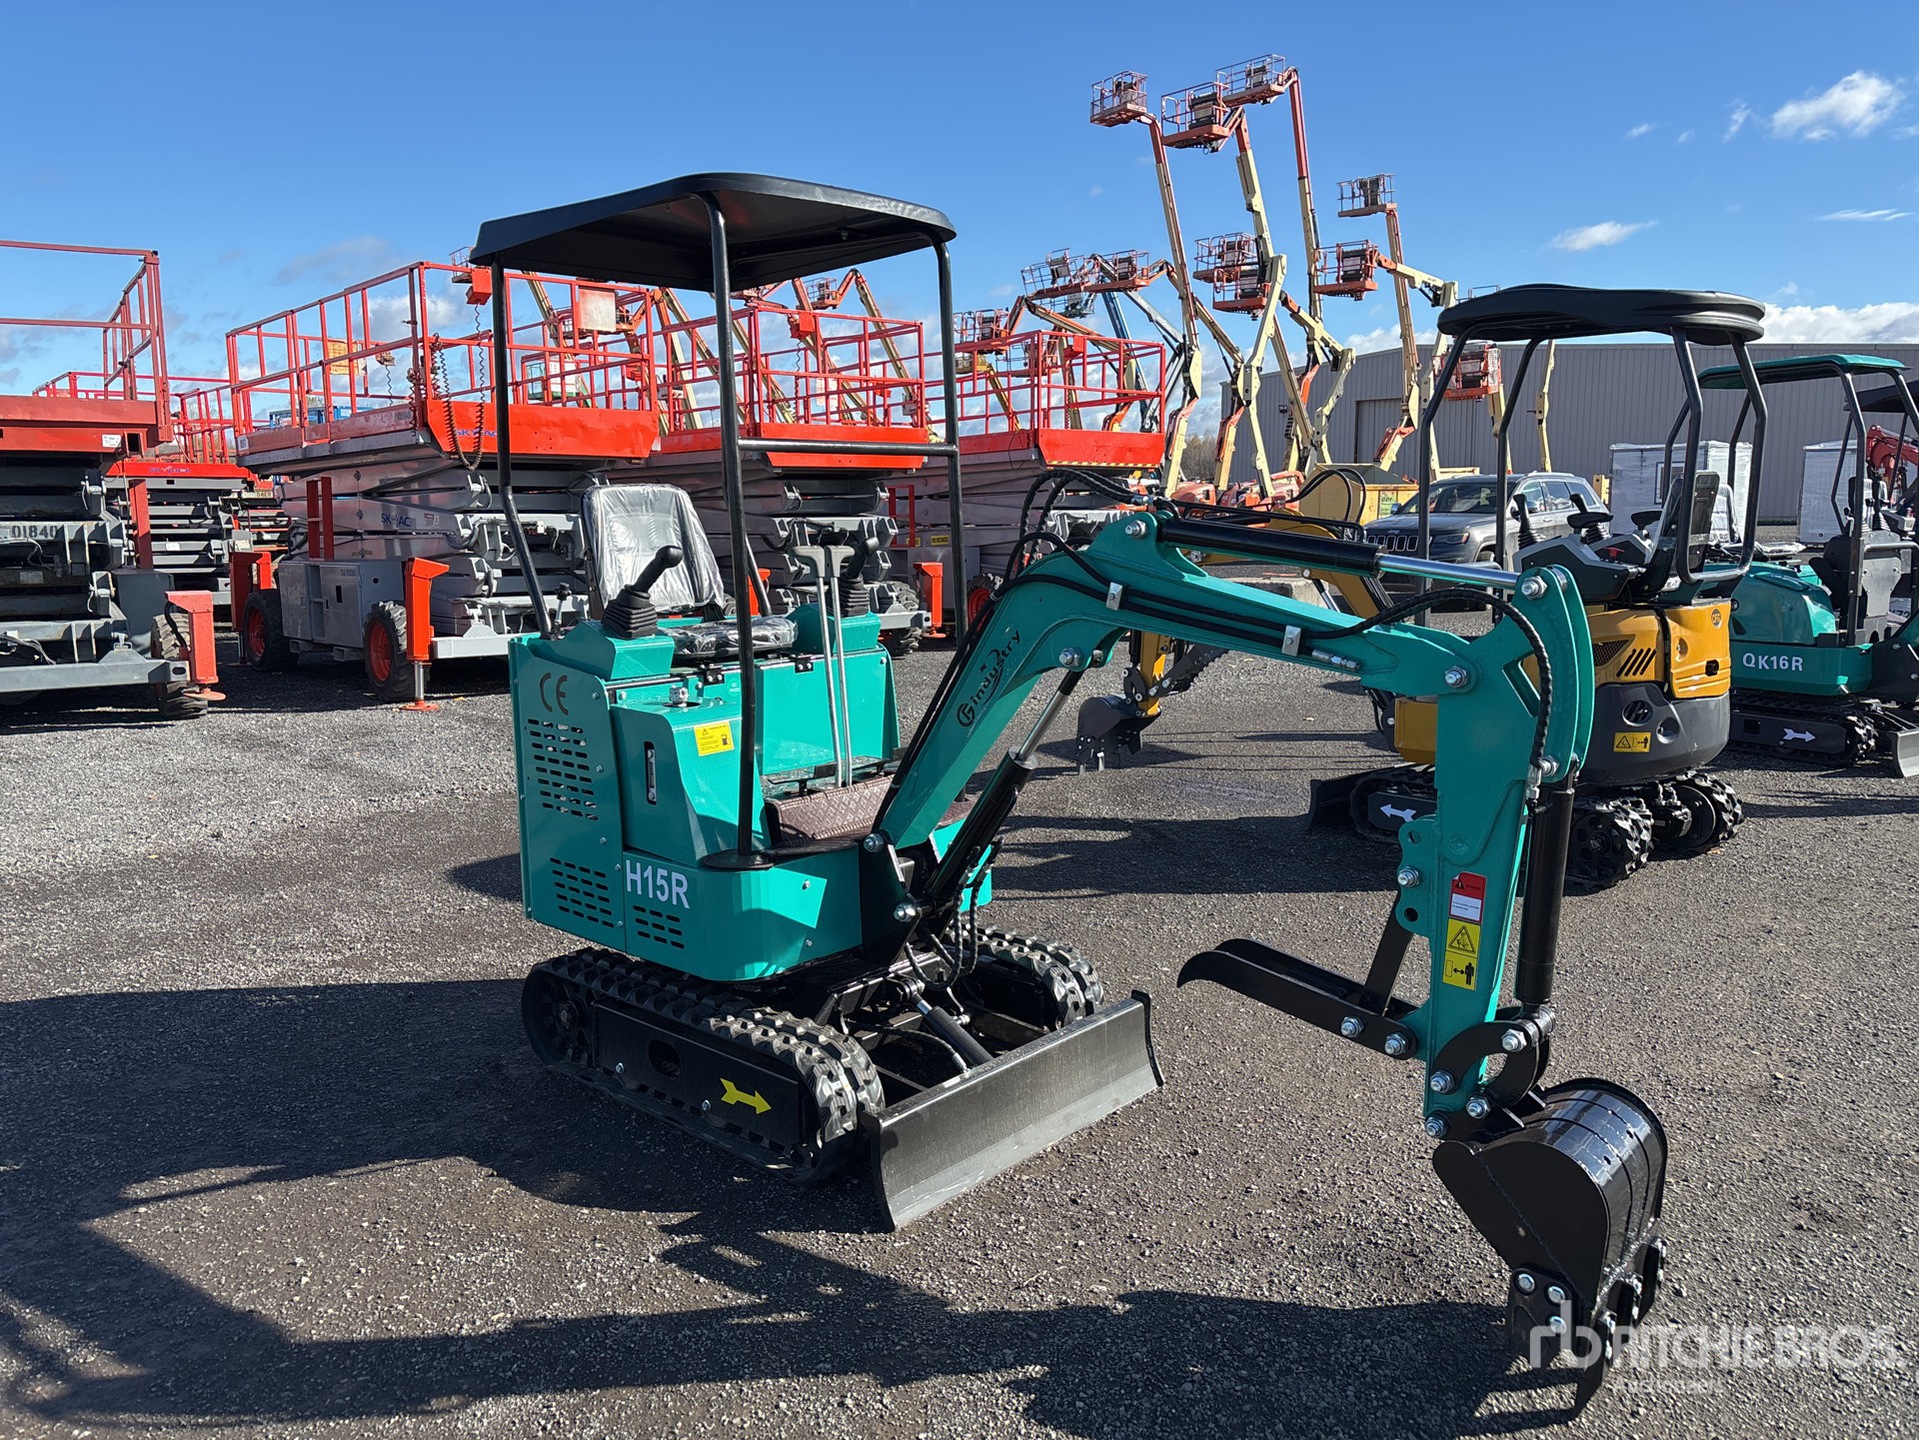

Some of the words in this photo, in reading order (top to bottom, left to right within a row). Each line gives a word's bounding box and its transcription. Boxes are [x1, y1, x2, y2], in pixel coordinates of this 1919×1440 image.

[1742, 652, 1804, 672] QK16R
[540, 672, 569, 716] CE
[626, 859, 691, 910] H15R
